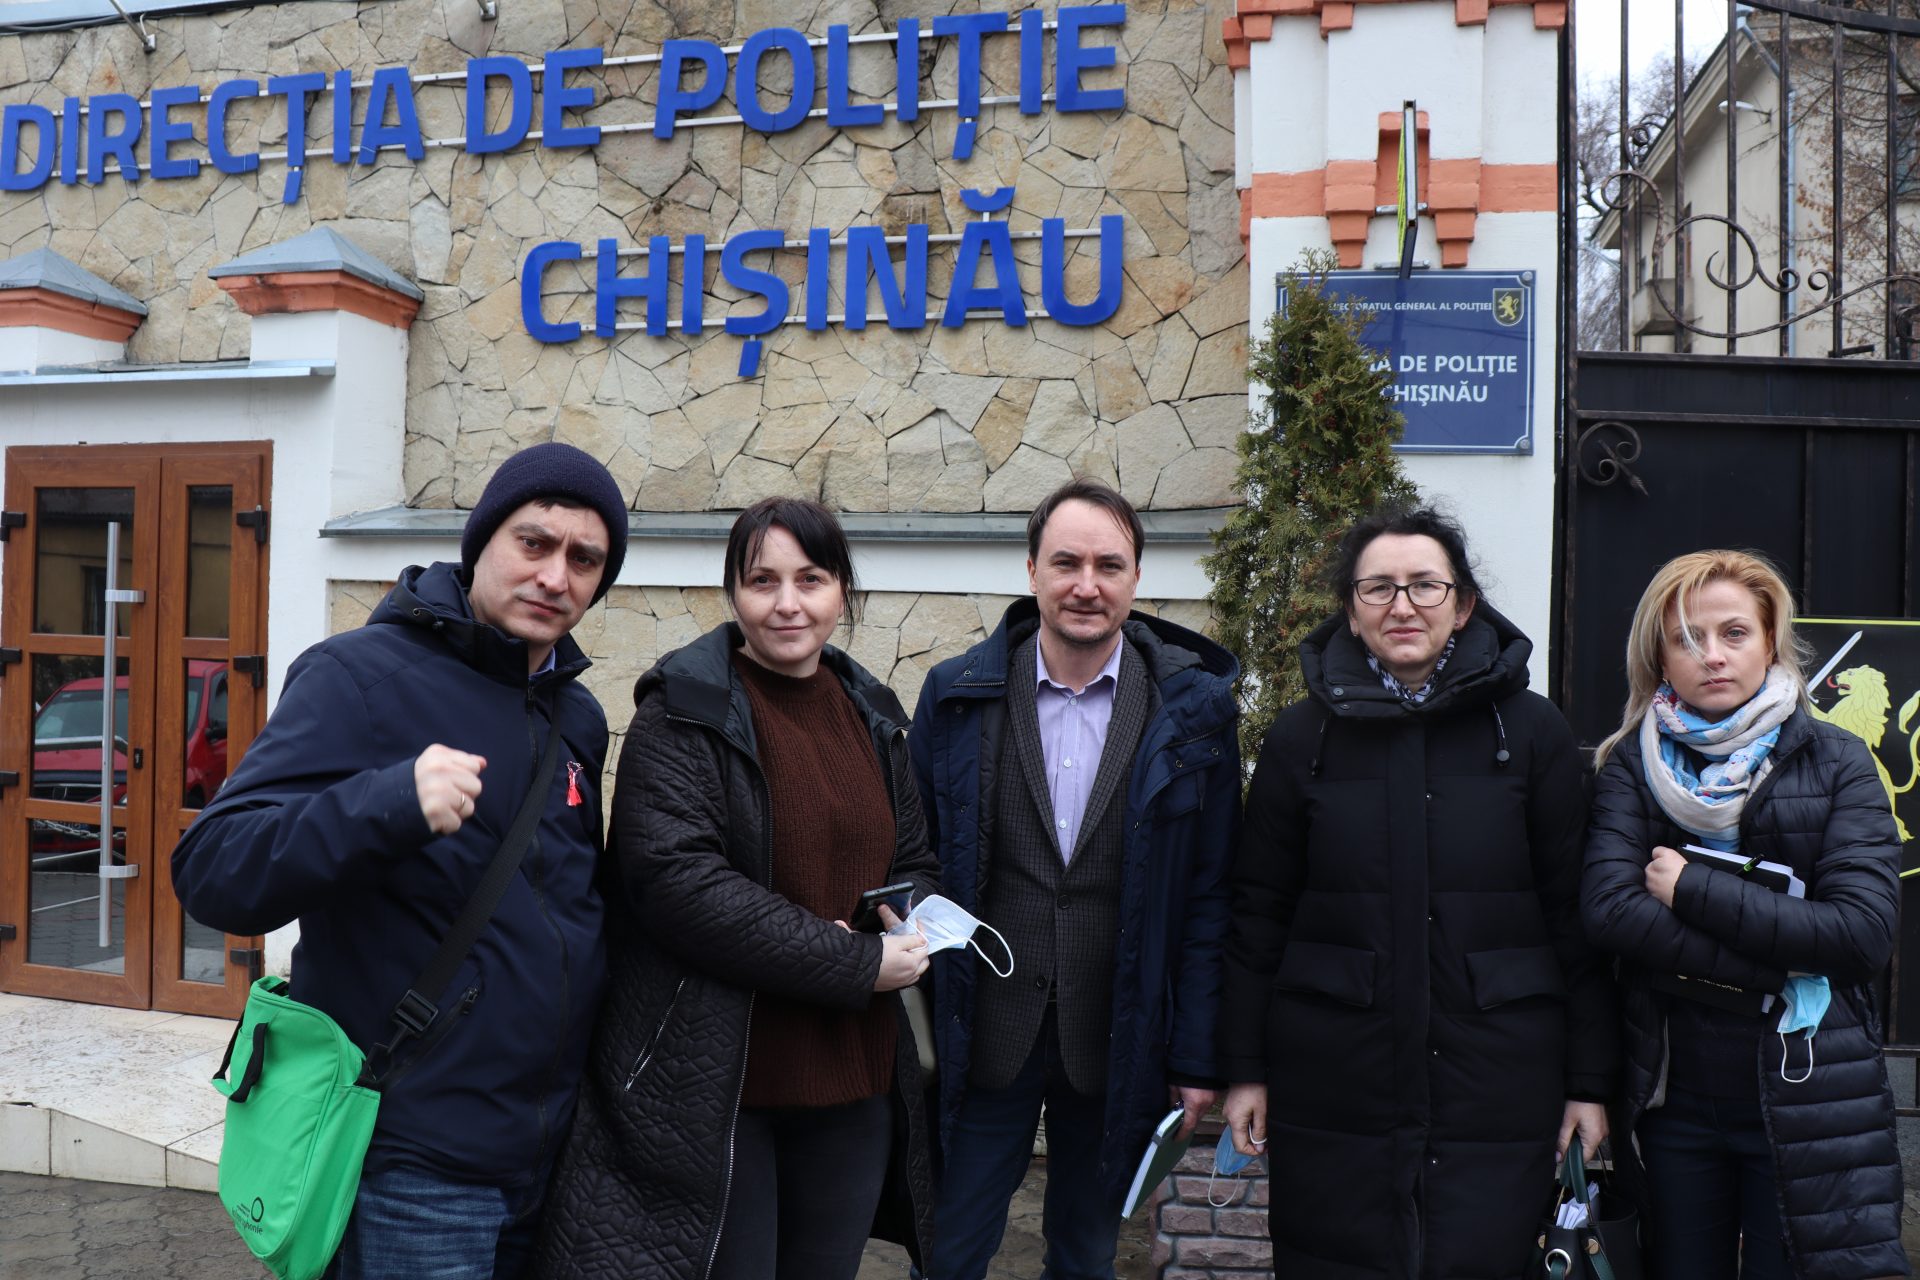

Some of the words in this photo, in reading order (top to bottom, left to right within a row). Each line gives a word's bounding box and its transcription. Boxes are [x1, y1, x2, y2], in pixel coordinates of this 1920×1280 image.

[0, 66, 425, 204] DIRECȚIA
[465, 47, 604, 155] DE
[653, 4, 1127, 160] POLIȚIE
[521, 186, 1124, 377] CHIȘINĂU
[1394, 302, 1437, 311] GENERAL
[1439, 302, 1452, 311] AL
[1399, 355, 1428, 373] DE
